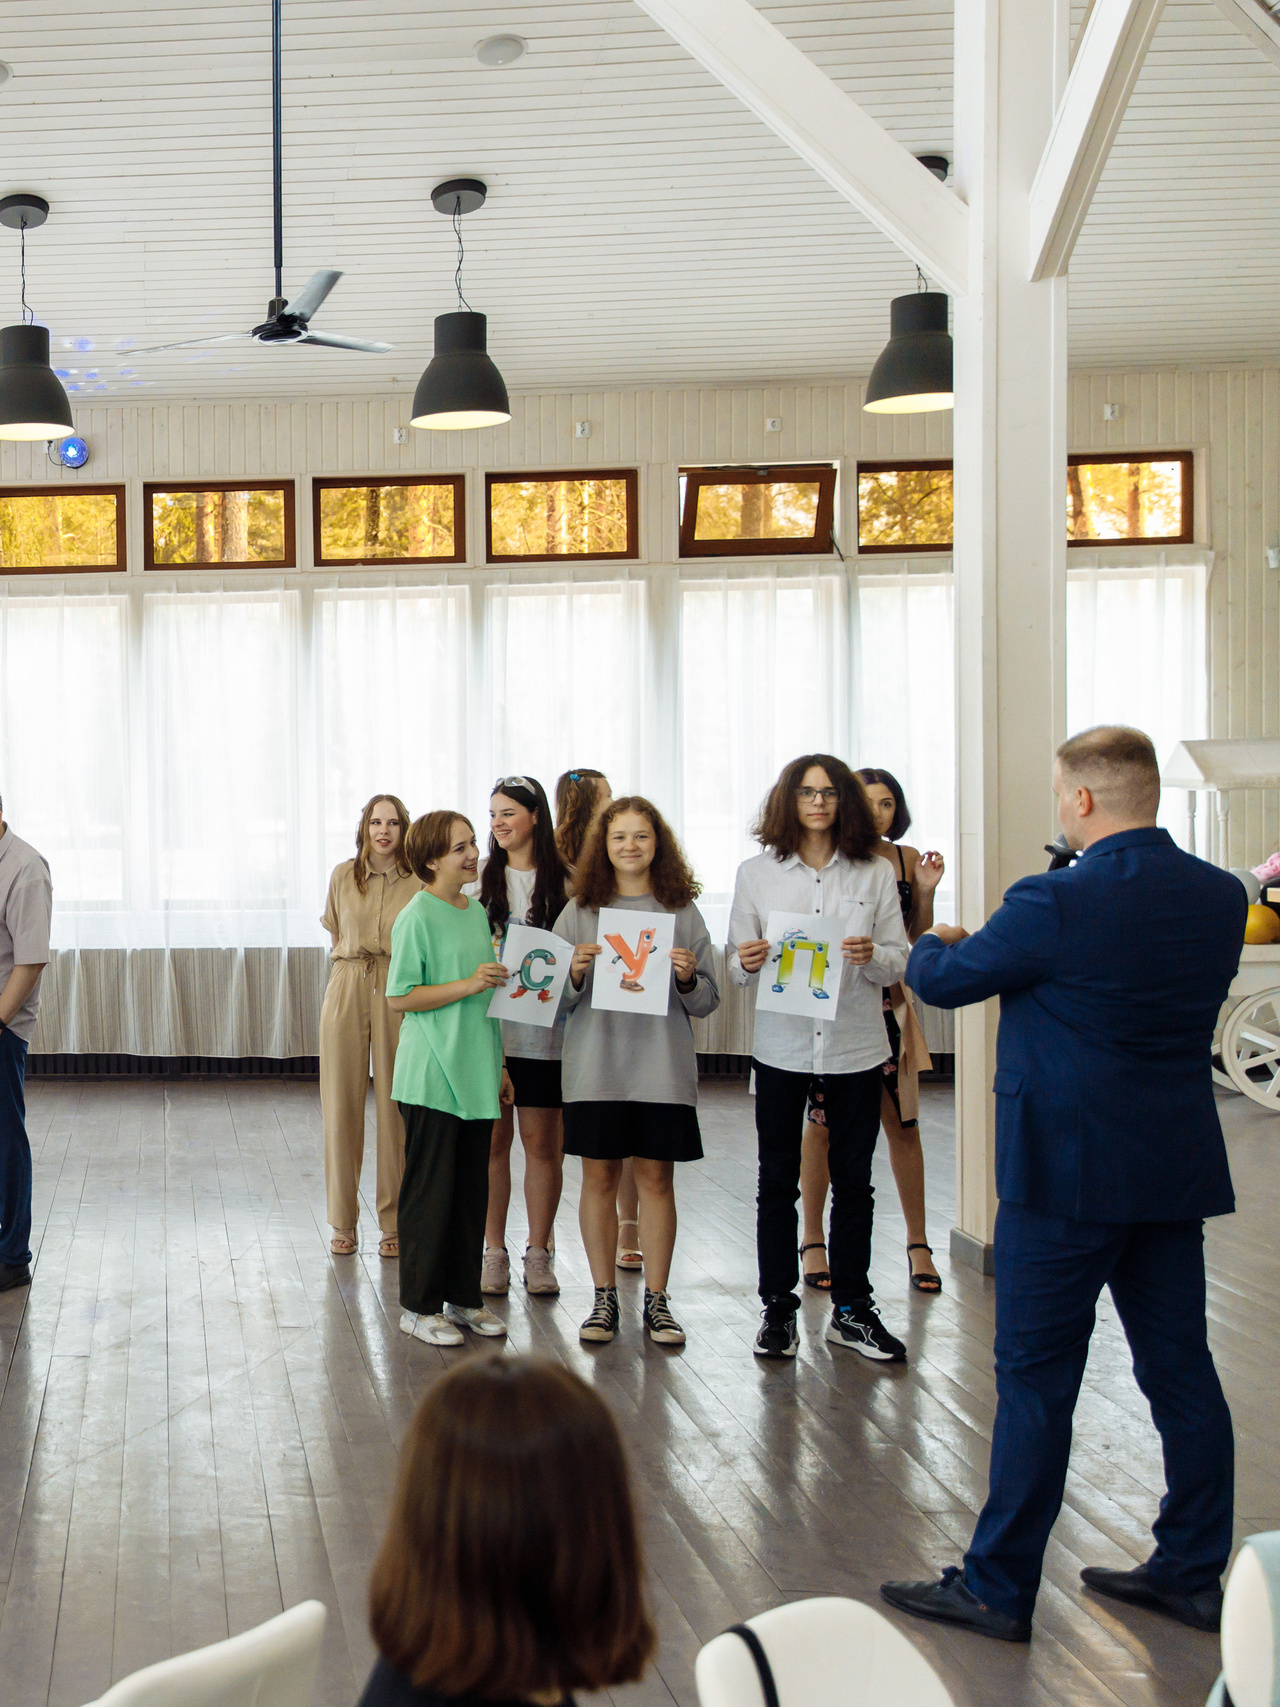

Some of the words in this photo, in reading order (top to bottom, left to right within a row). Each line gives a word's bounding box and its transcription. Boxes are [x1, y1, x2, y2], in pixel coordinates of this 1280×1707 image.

[520, 949, 556, 991] С
[603, 928, 657, 981] У
[777, 941, 829, 989] П
